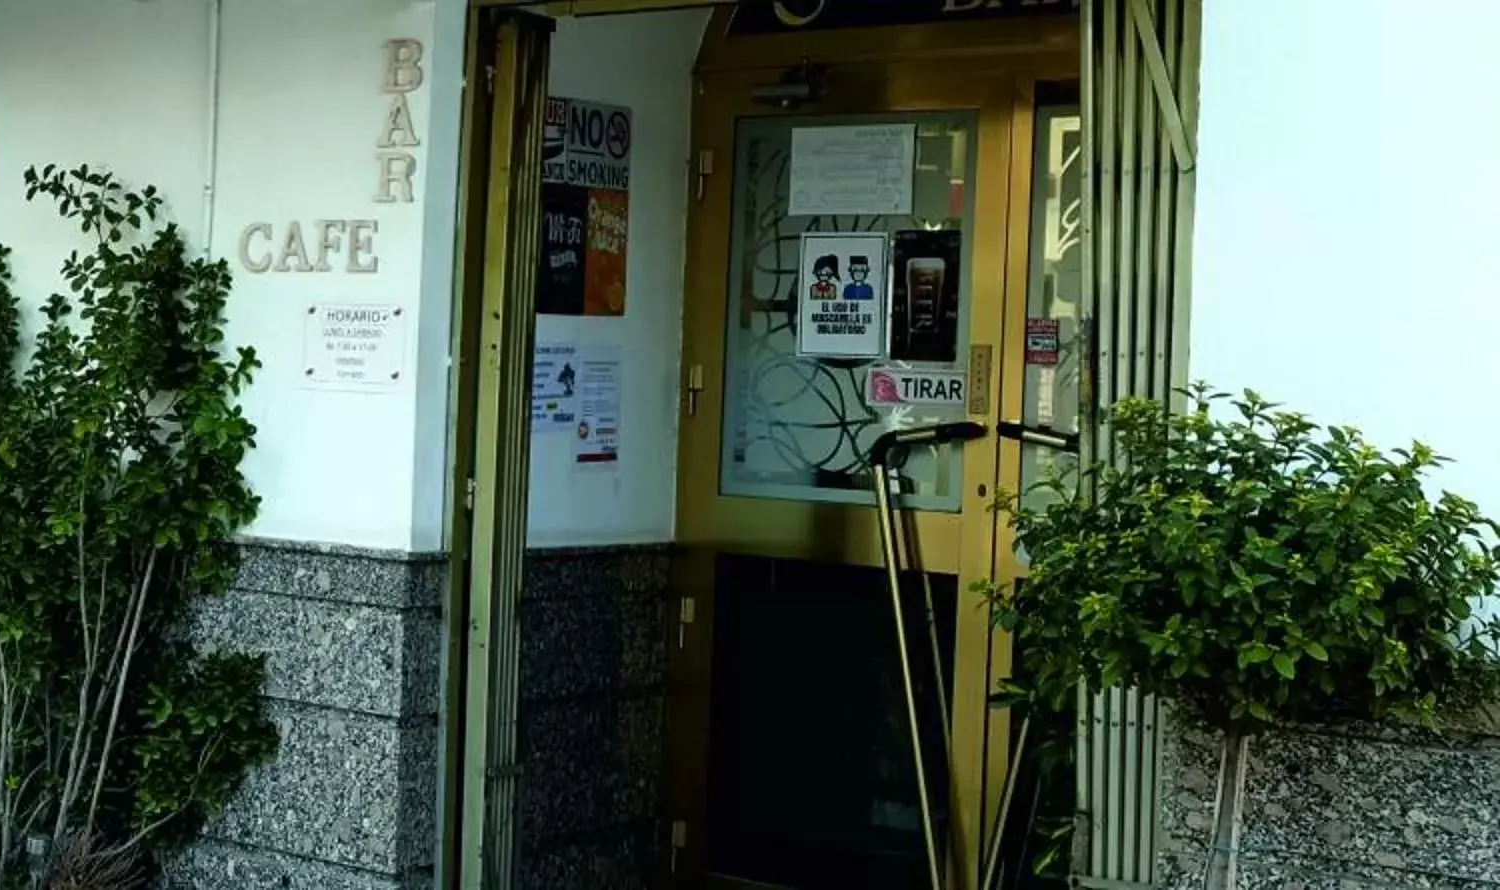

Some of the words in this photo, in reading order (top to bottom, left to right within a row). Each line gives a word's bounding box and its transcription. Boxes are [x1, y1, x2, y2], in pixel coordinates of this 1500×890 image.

[374, 38, 424, 203] BAR
[571, 106, 604, 149] NO
[568, 160, 629, 188] SMOKING
[238, 218, 379, 274] CAFE
[327, 309, 380, 322] HORARIO
[900, 376, 963, 401] TIRAR
